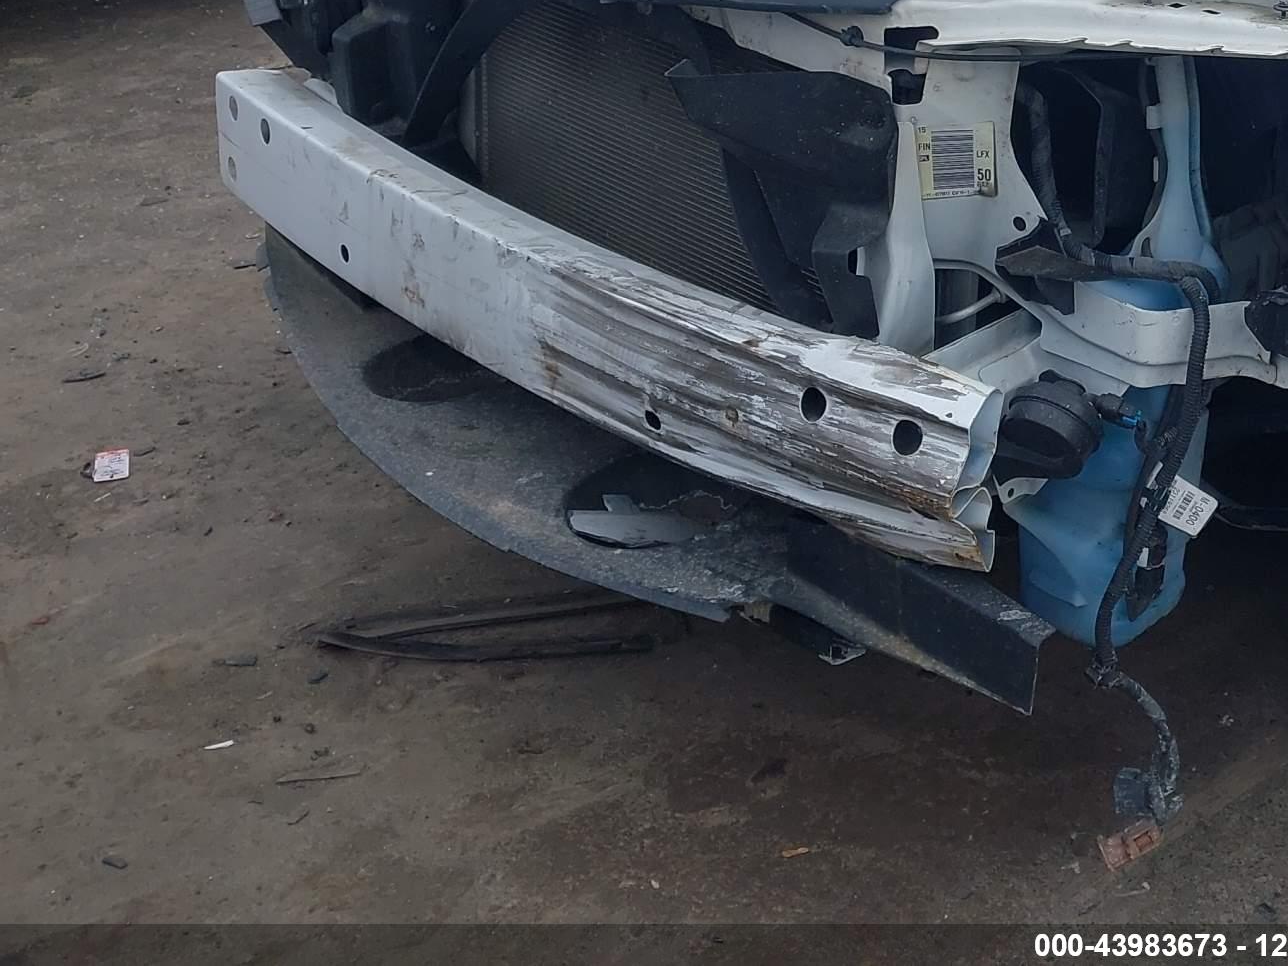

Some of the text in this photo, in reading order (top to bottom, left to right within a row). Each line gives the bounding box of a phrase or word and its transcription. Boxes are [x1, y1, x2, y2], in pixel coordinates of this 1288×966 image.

[918, 126, 927, 134] 15
[918, 142, 931, 151] FIN
[976, 150, 990, 159] LFX
[977, 168, 991, 181] 50
